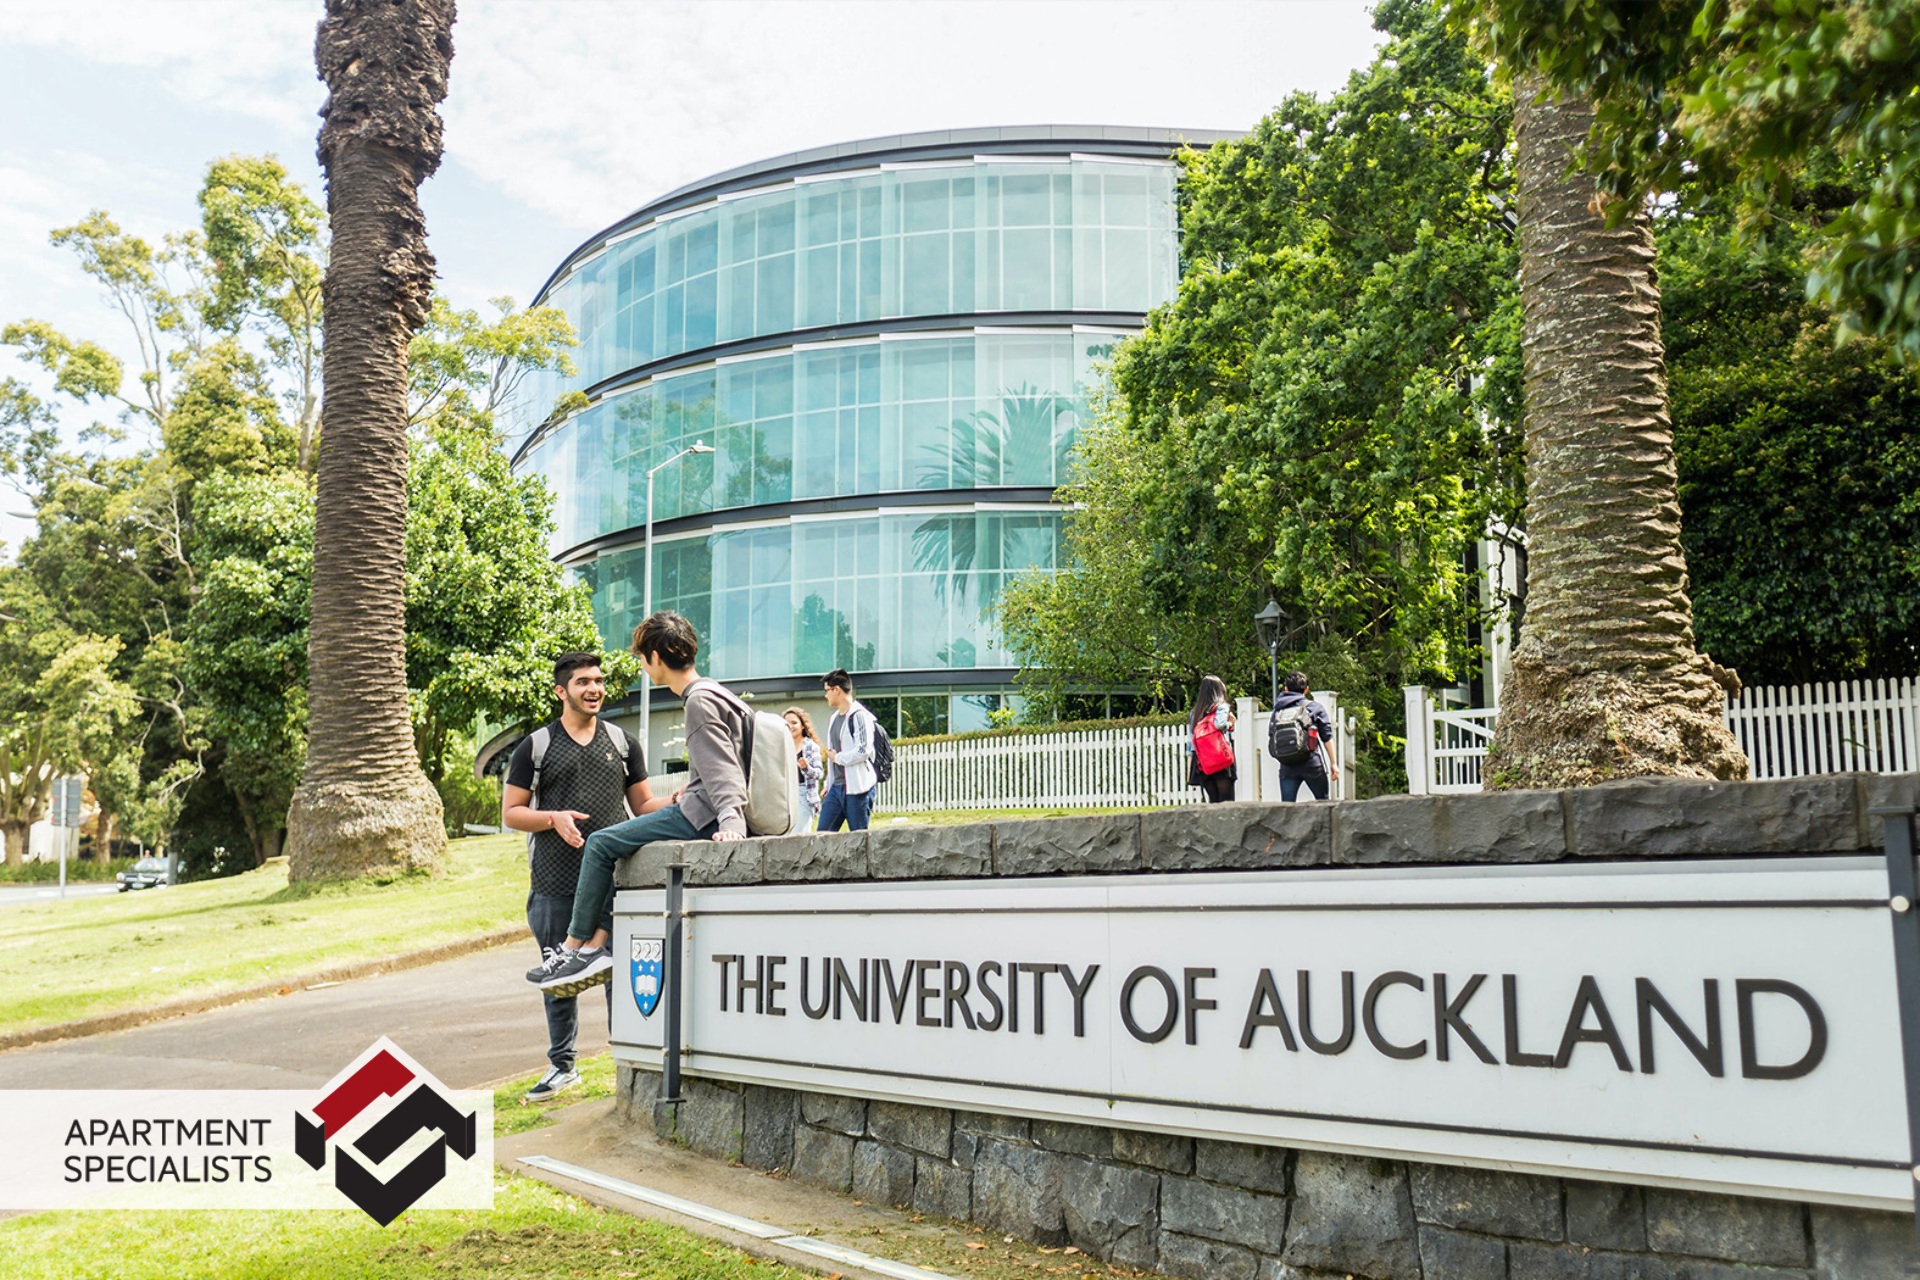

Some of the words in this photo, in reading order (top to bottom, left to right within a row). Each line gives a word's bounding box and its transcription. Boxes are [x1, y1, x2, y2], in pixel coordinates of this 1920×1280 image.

[711, 954, 787, 1016] THE
[800, 956, 1101, 1037] UNIVERSITY
[1119, 965, 1218, 1046] OF
[1238, 968, 1829, 1080] AUCKLAND
